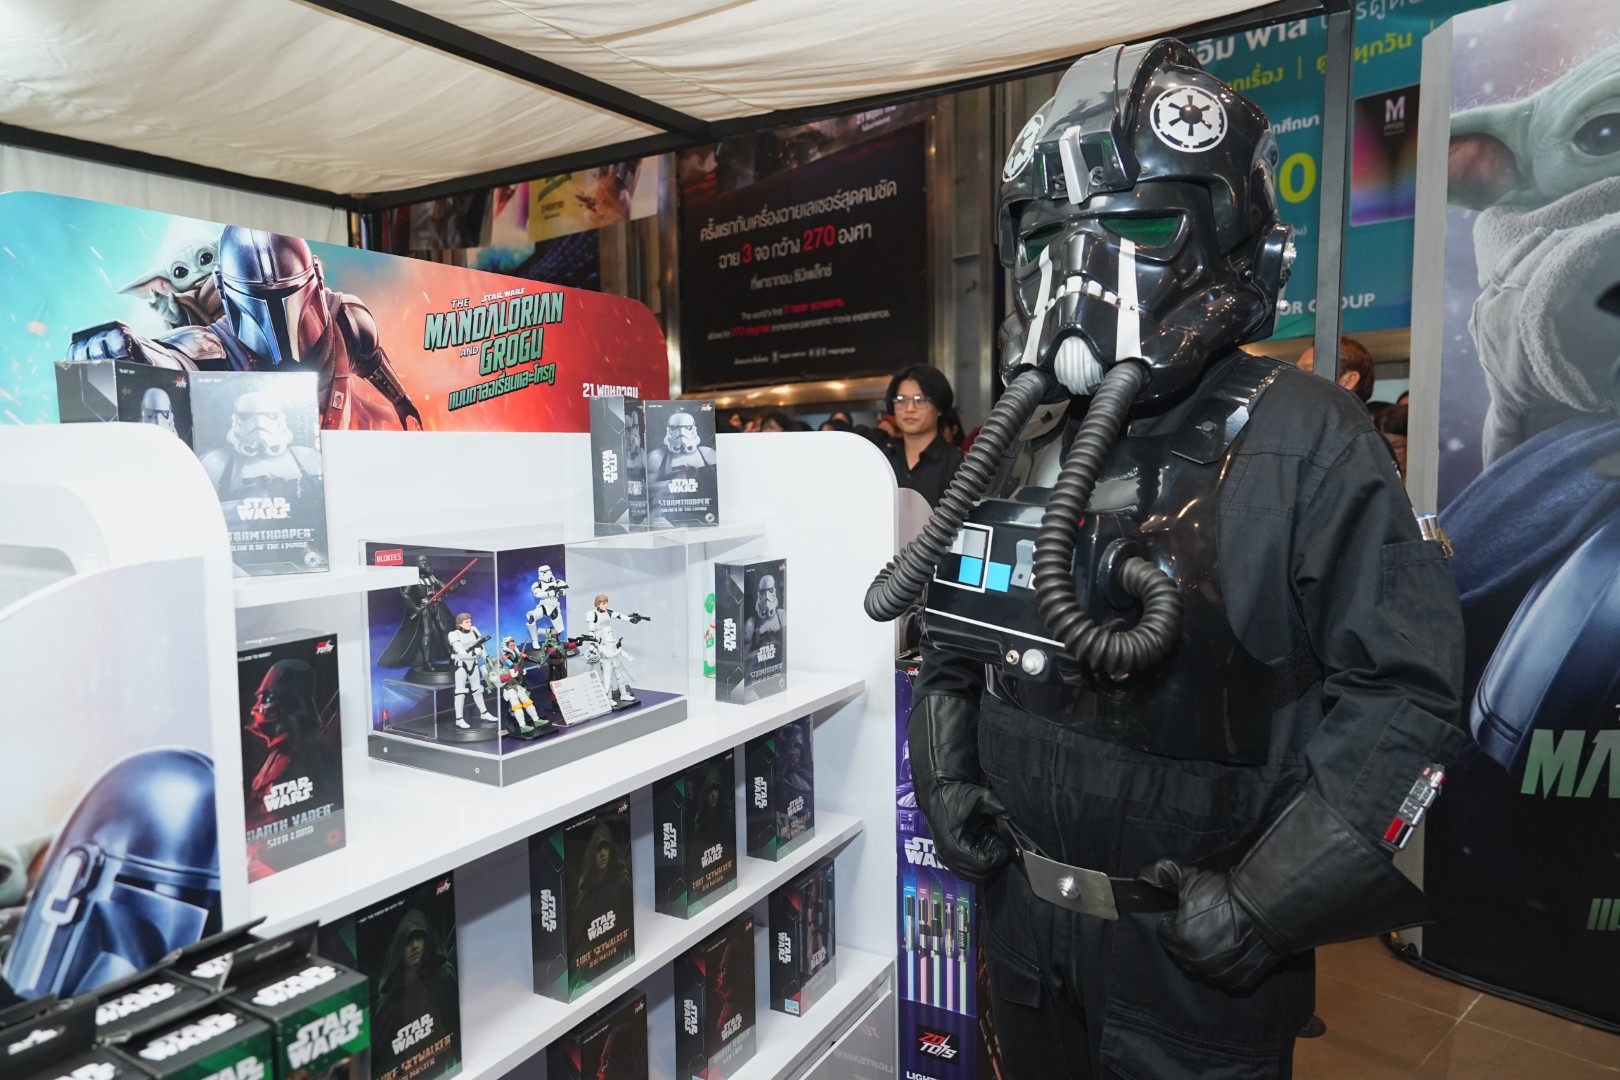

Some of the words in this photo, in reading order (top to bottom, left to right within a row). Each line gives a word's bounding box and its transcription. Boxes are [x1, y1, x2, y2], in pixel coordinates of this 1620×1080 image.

[1273, 152, 1316, 204] 0
[742, 244, 753, 264] 3
[754, 246, 770, 262] จอ
[802, 225, 836, 251] 270
[838, 222, 873, 245] องศา
[451, 298, 470, 310] THE
[481, 291, 504, 303] STAR
[504, 287, 526, 297] WARS
[423, 291, 565, 352] MANDALORIAN
[460, 345, 479, 358] AND
[479, 327, 545, 376] GROGU
[583, 382, 595, 398] 21
[668, 478, 699, 488] STAR
[668, 485, 699, 493] WARS
[237, 497, 291, 510] STAR
[238, 507, 291, 520] WARS
[376, 553, 402, 564] BLOKEES
[264, 776, 314, 801] STAR
[264, 786, 314, 812] WARS
[292, 804, 331, 825] VADER
[587, 910, 616, 933] STAR
[587, 917, 616, 941] WARS
[287, 1003, 363, 1050] STAR
[392, 1014, 434, 1043] STAR
[392, 1022, 434, 1055] WARS
[919, 1032, 946, 1045] ZD
[287, 1018, 363, 1070] WARS
[920, 1035, 957, 1059] TOYS
